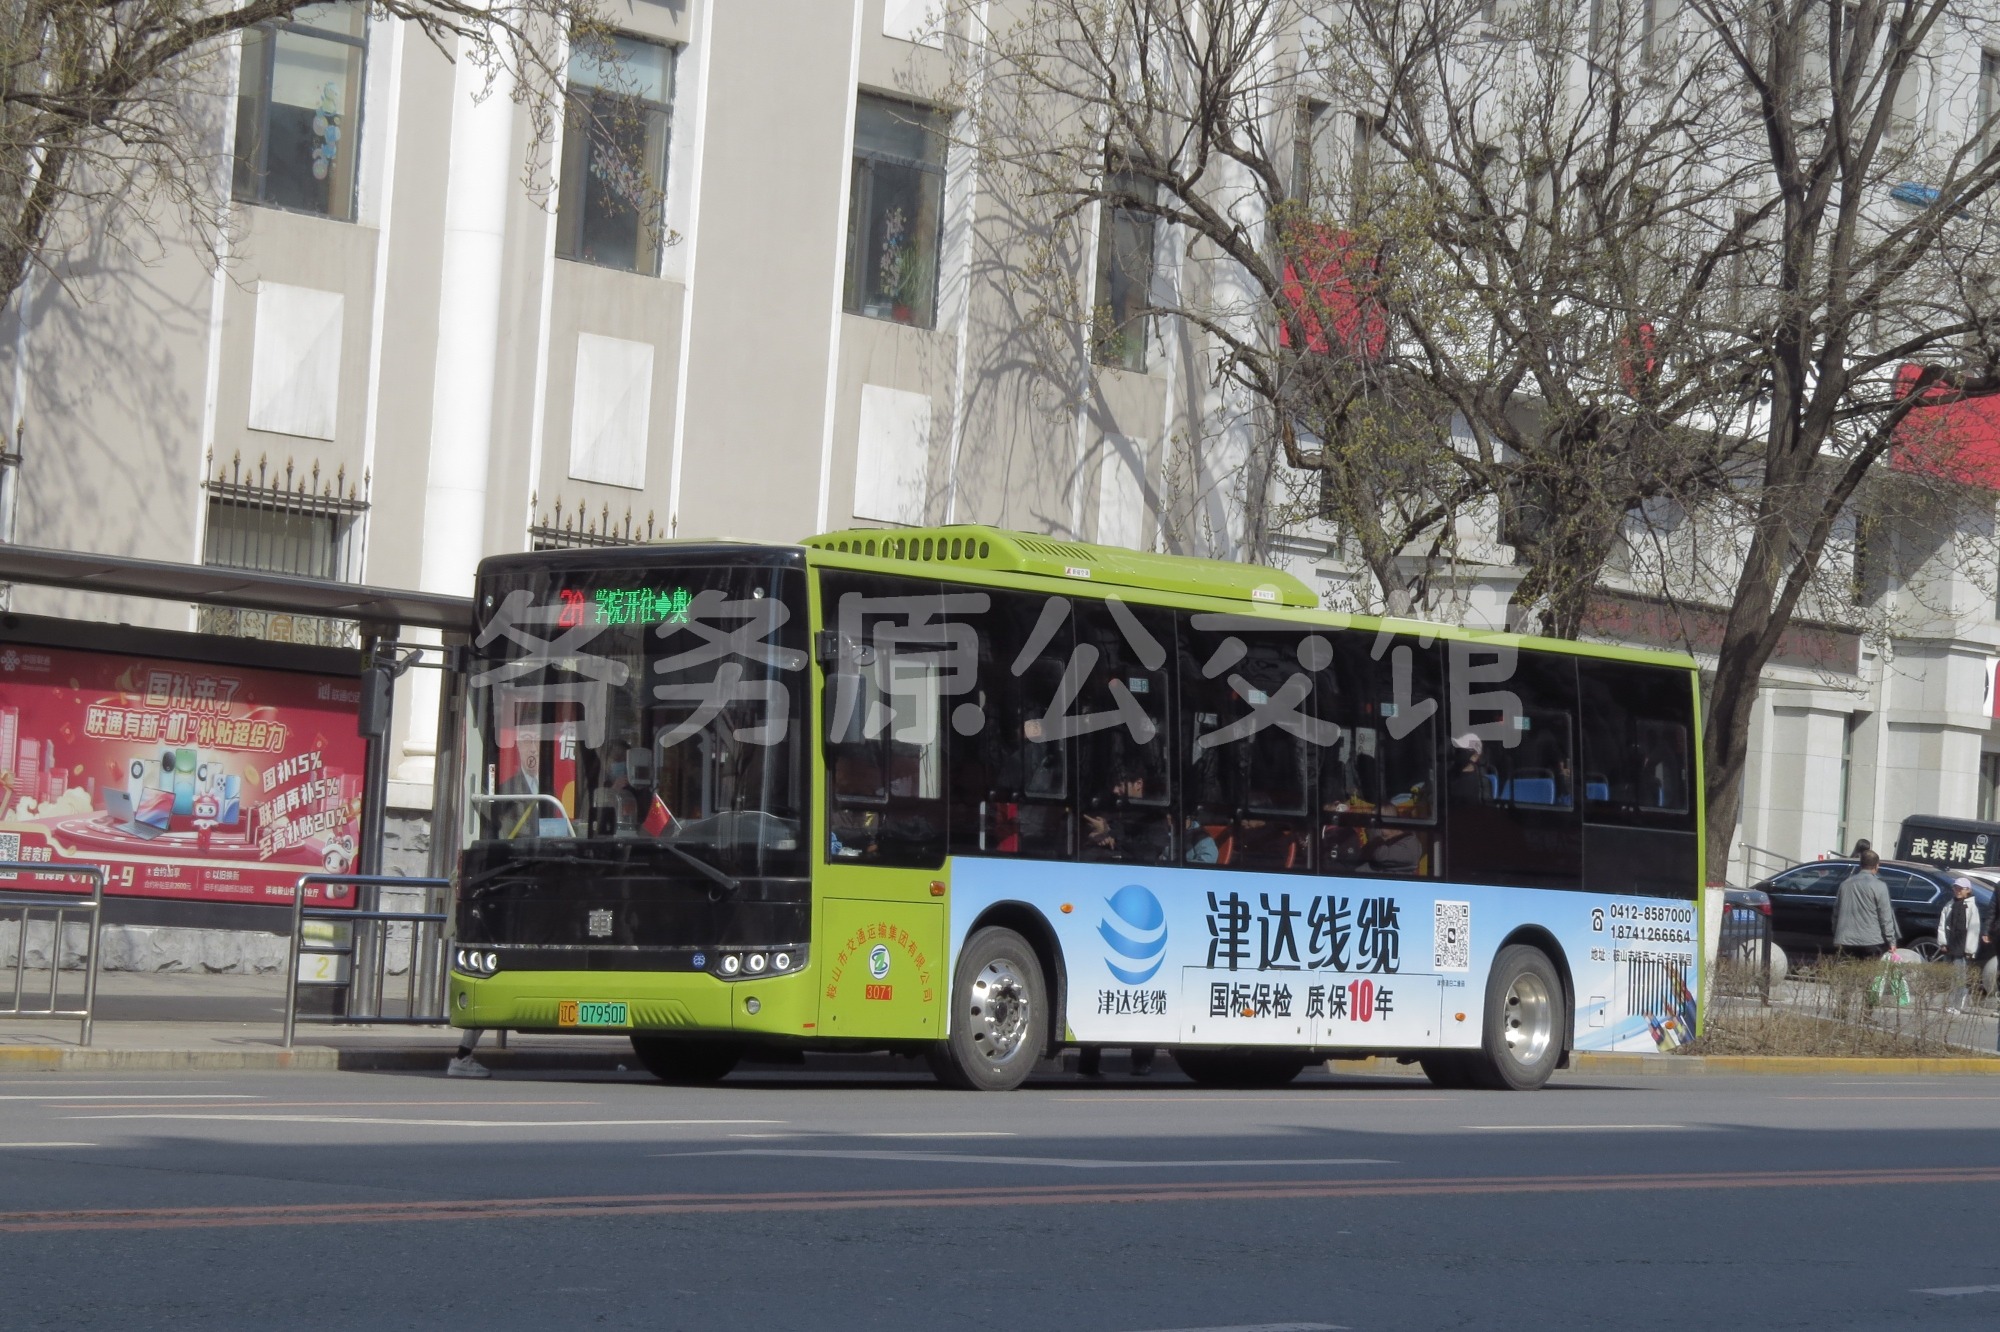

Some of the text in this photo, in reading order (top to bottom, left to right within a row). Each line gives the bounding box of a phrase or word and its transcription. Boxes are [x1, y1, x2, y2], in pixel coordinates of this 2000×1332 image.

[595, 587, 656, 626] 学院开往
[144, 670, 241, 714] 国补来了
[262, 751, 323, 793] 国补15%
[259, 777, 338, 827] 联通再补5%
[21, 846, 53, 862] 装宽带
[259, 807, 348, 861] 至高补贴20%
[1911, 837, 1986, 865] 武装押运
[1206, 891, 1401, 973] 津达线缆
[1610, 904, 1692, 923] 0412-8587000
[1610, 925, 1691, 943] 18741266664
[826, 922, 933, 1002] 鞍山市交通运输集团有限公司
[866, 985, 892, 999] 3071
[1097, 989, 1168, 1016] 津达线缆
[1209, 978, 1394, 1022] 国标保检 质保10年
